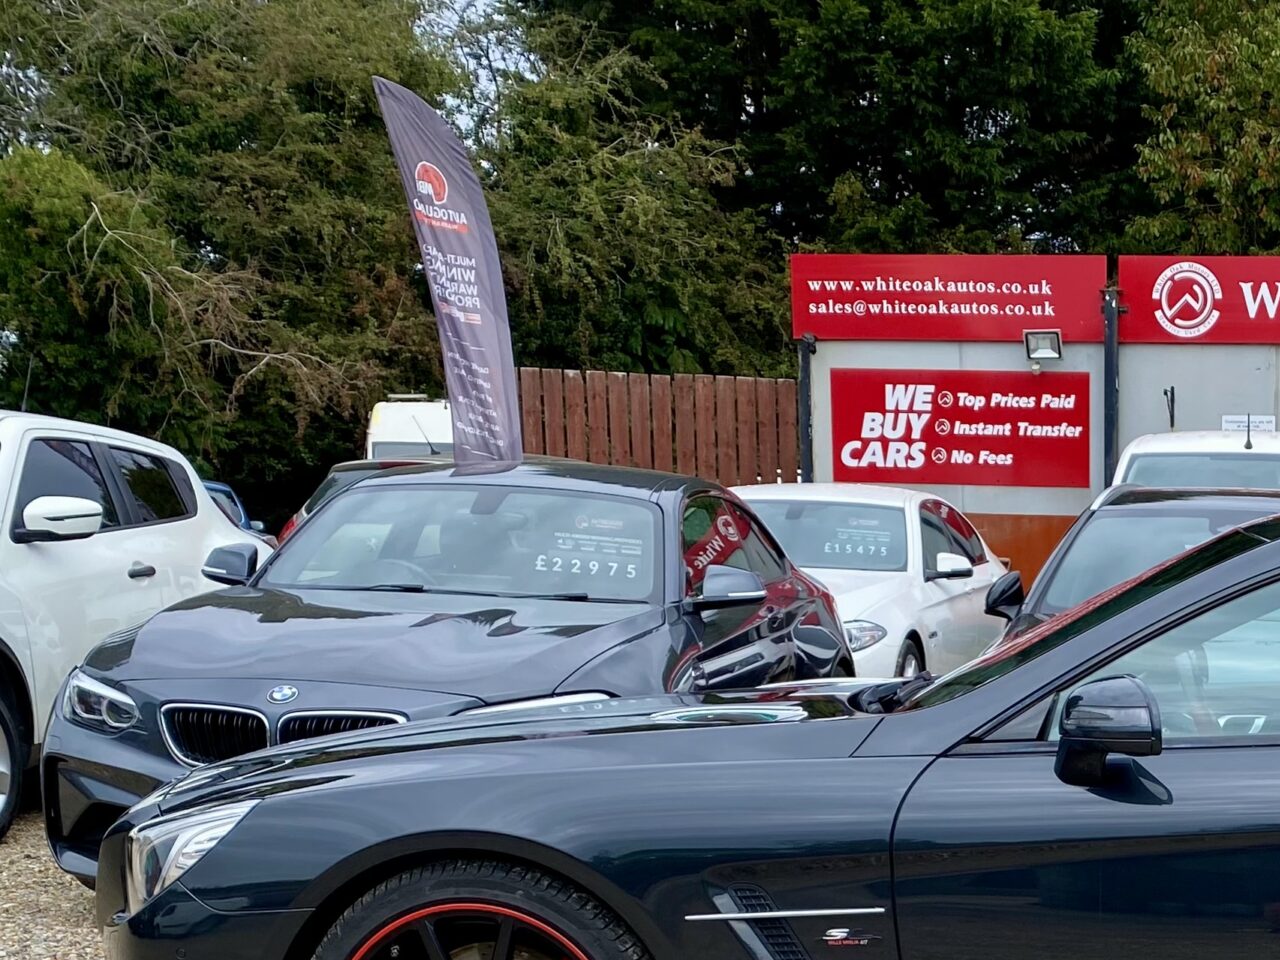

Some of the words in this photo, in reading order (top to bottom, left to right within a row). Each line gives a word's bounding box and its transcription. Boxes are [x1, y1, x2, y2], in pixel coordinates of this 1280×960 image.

[807, 276, 1052, 295] www.whiteoakautos.co.uk
[808, 299, 1055, 317] sales@whiteoakautos.co.uk
[885, 384, 936, 412] WE
[956, 392, 986, 411] Top
[990, 392, 1036, 408] Prices
[1040, 393, 1076, 409] Paid
[860, 411, 932, 440] BUY
[953, 420, 1012, 436] Instant
[1017, 421, 1083, 438] Transfer
[840, 440, 927, 469] CARS
[950, 449, 974, 465] No
[978, 450, 1014, 465] Fees
[535, 554, 637, 579] £22975
